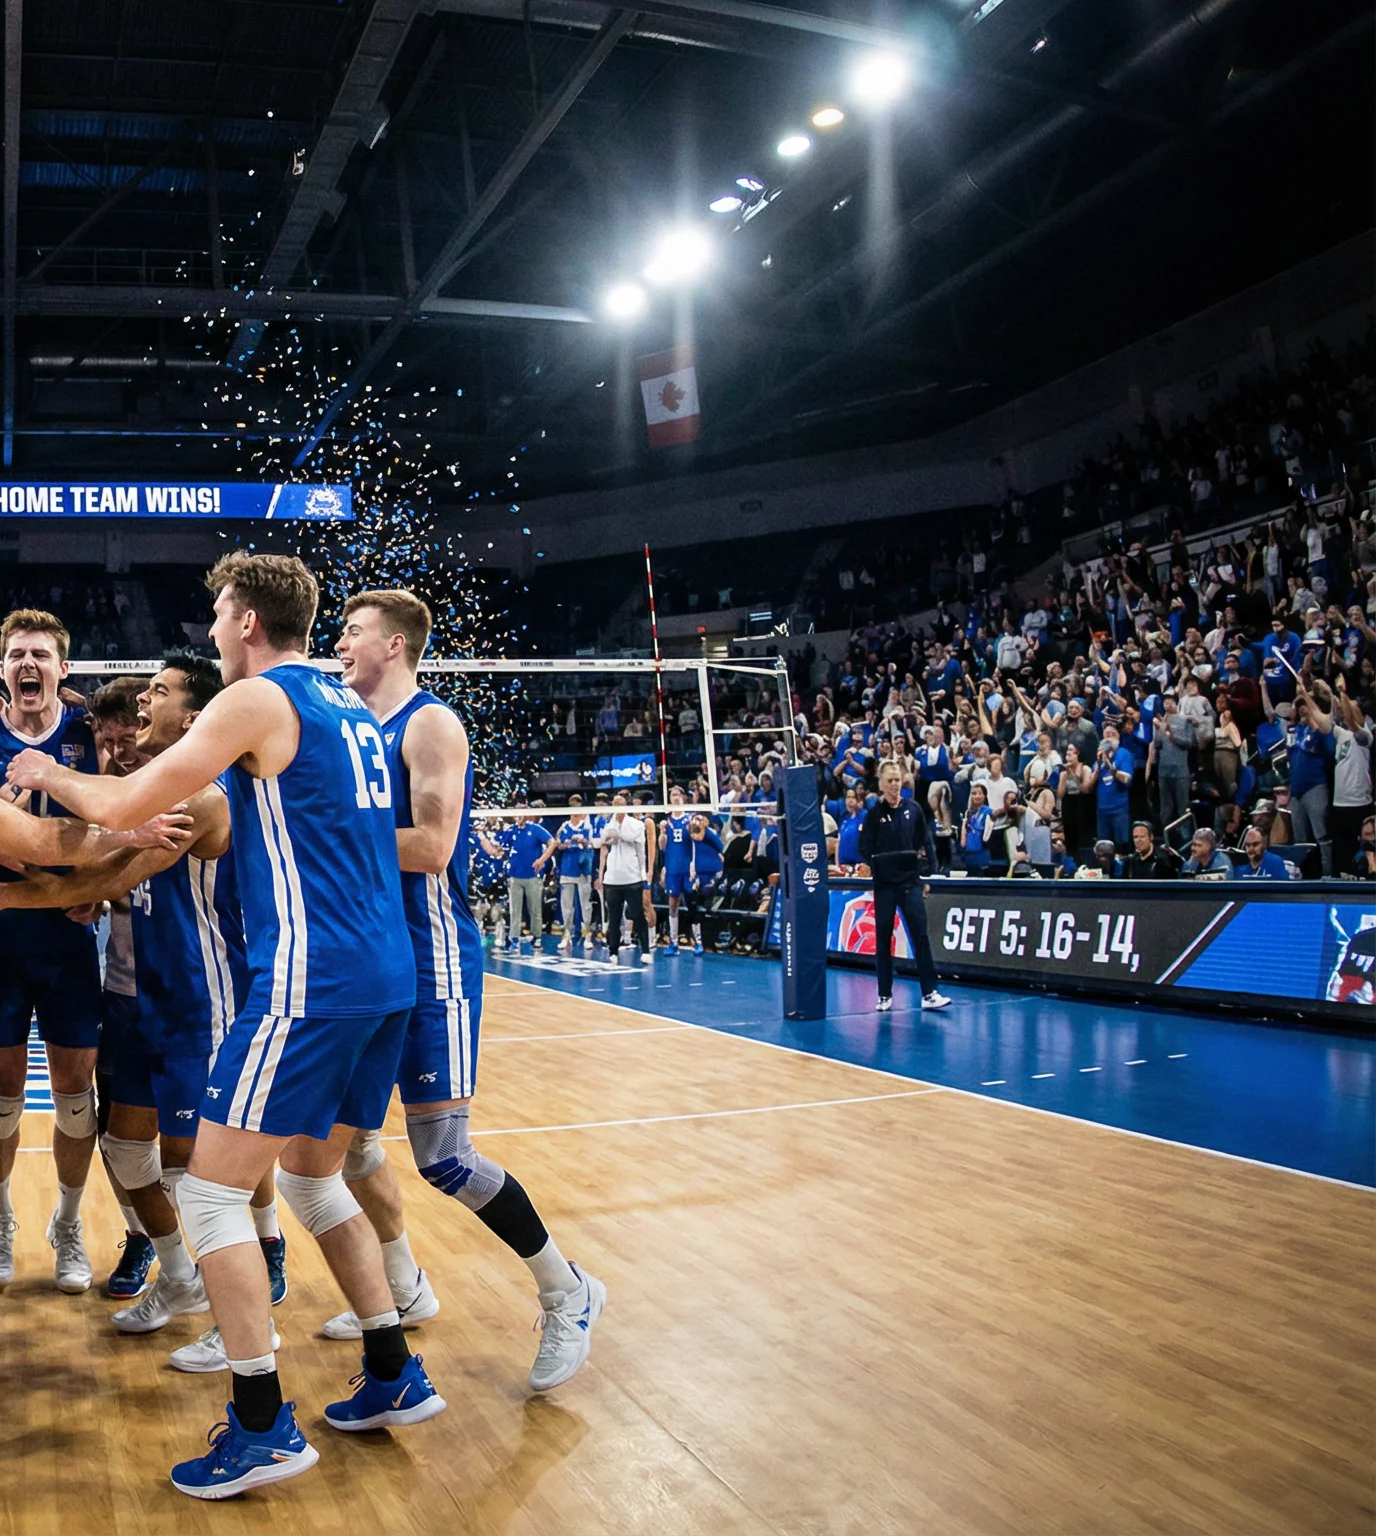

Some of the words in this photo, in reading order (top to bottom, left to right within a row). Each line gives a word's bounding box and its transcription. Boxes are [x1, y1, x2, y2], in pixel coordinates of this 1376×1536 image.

[69, 486, 142, 513] TEAM
[145, 486, 221, 513] WINS!
[340, 718, 392, 809] 13
[942, 907, 996, 953] SET
[999, 910, 1028, 956] 5:
[1035, 911, 1140, 973] 16-14,
